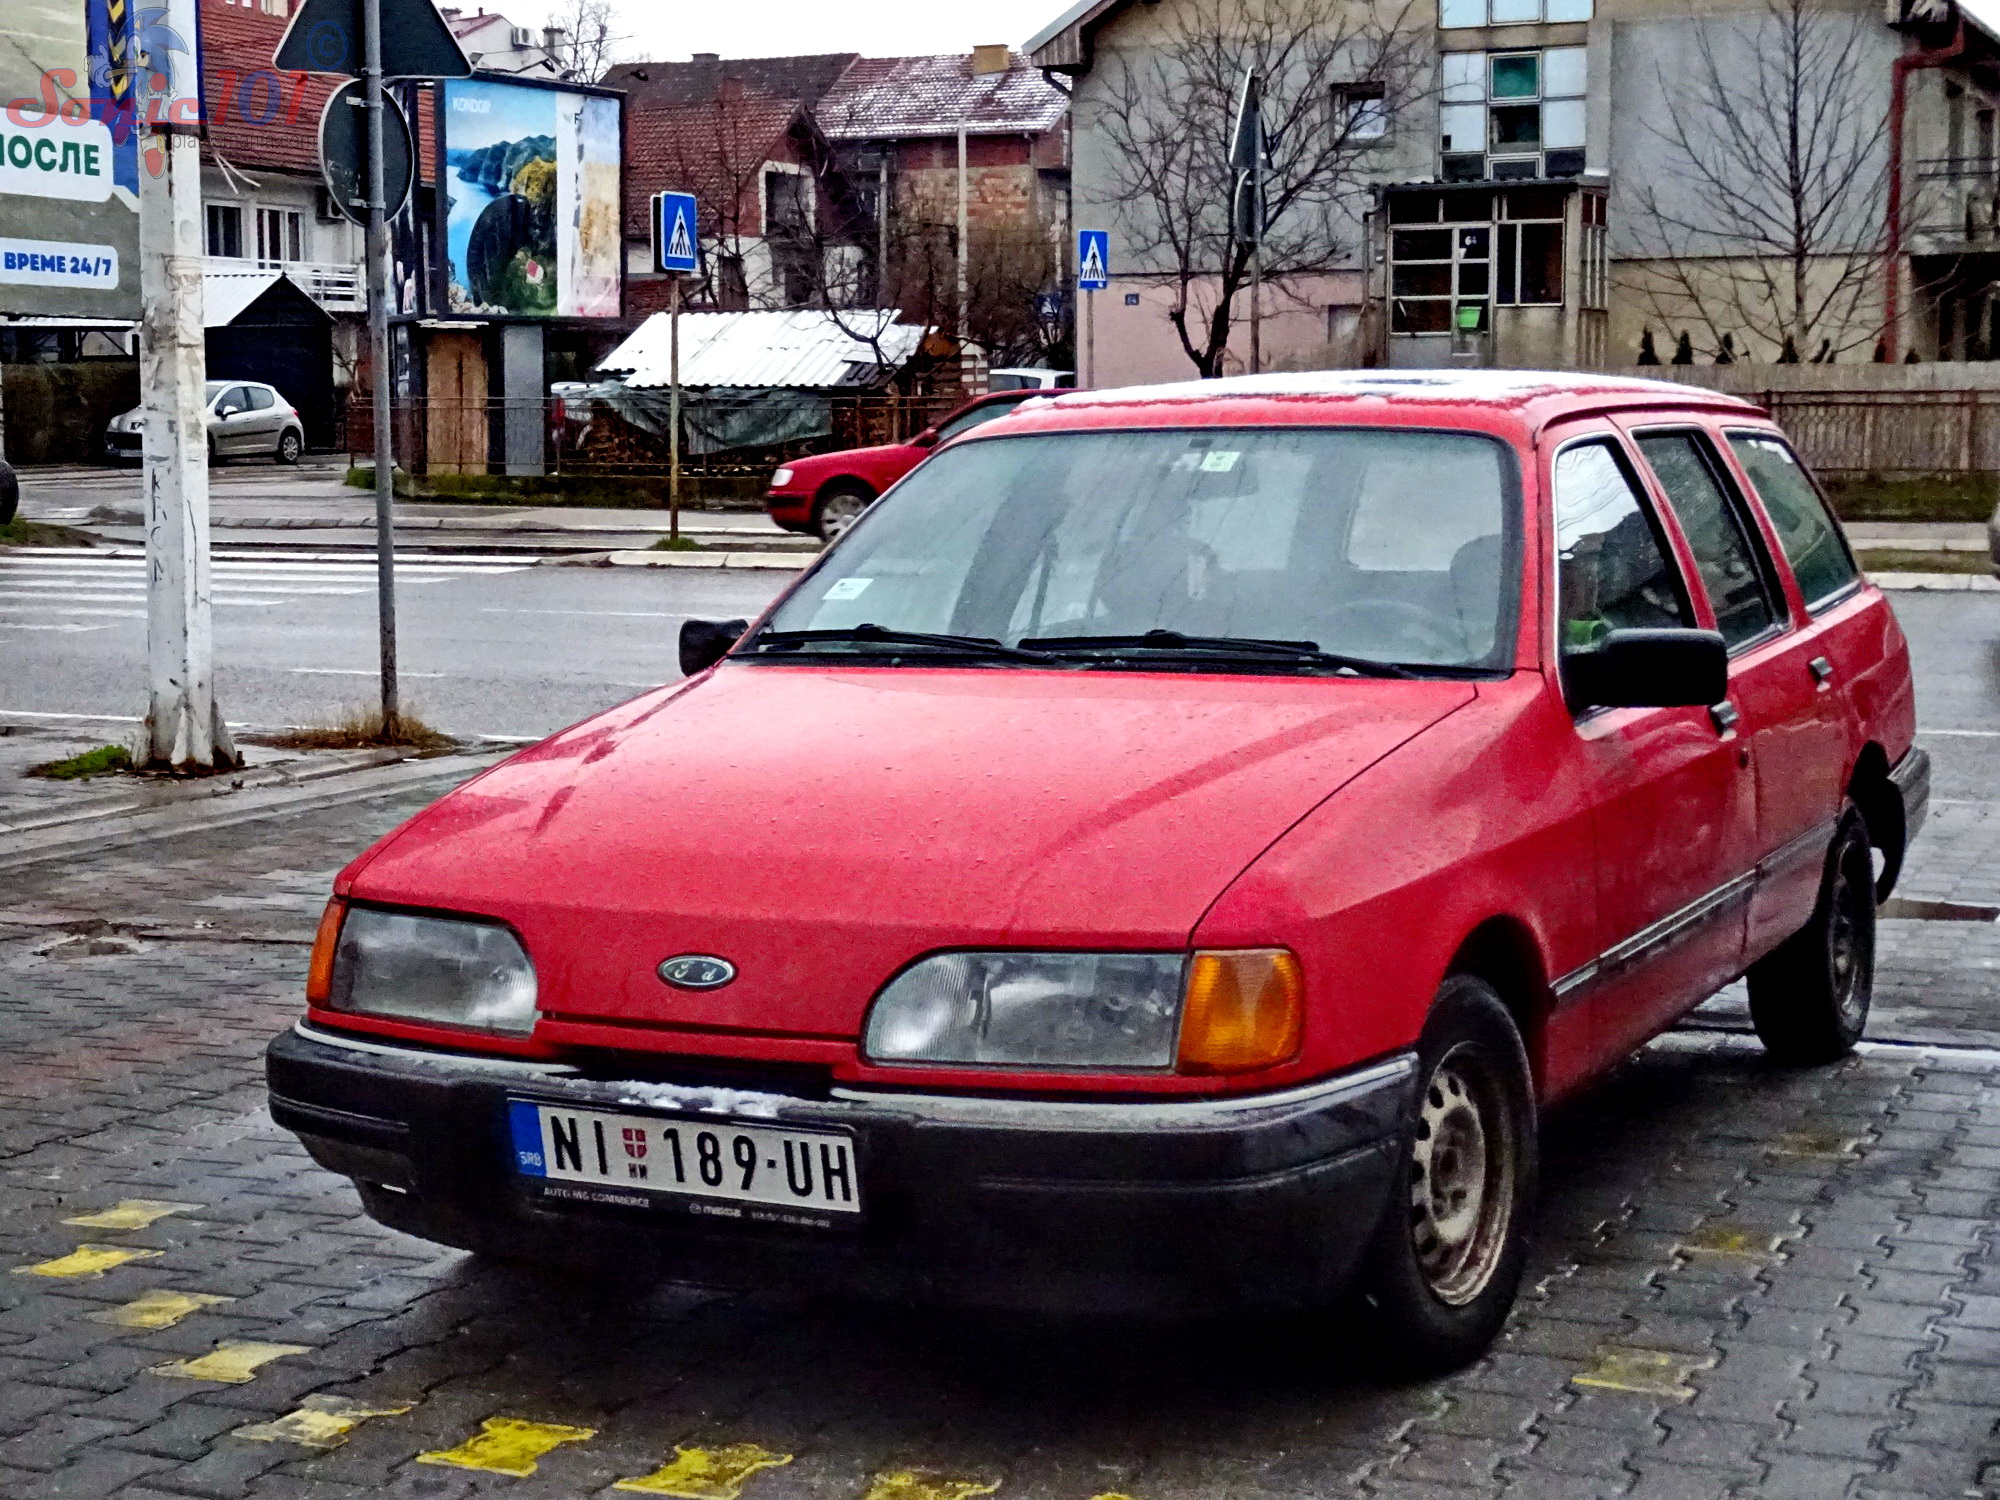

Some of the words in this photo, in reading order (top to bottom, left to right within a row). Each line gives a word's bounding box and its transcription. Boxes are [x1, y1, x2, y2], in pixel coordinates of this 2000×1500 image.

[0, 134, 100, 176] ОСЛЕ
[4, 251, 66, 273] ВРЕМЕ
[70, 256, 111, 277] 24/7
[519, 1151, 543, 1167] SRB
[551, 1115, 608, 1175] NI
